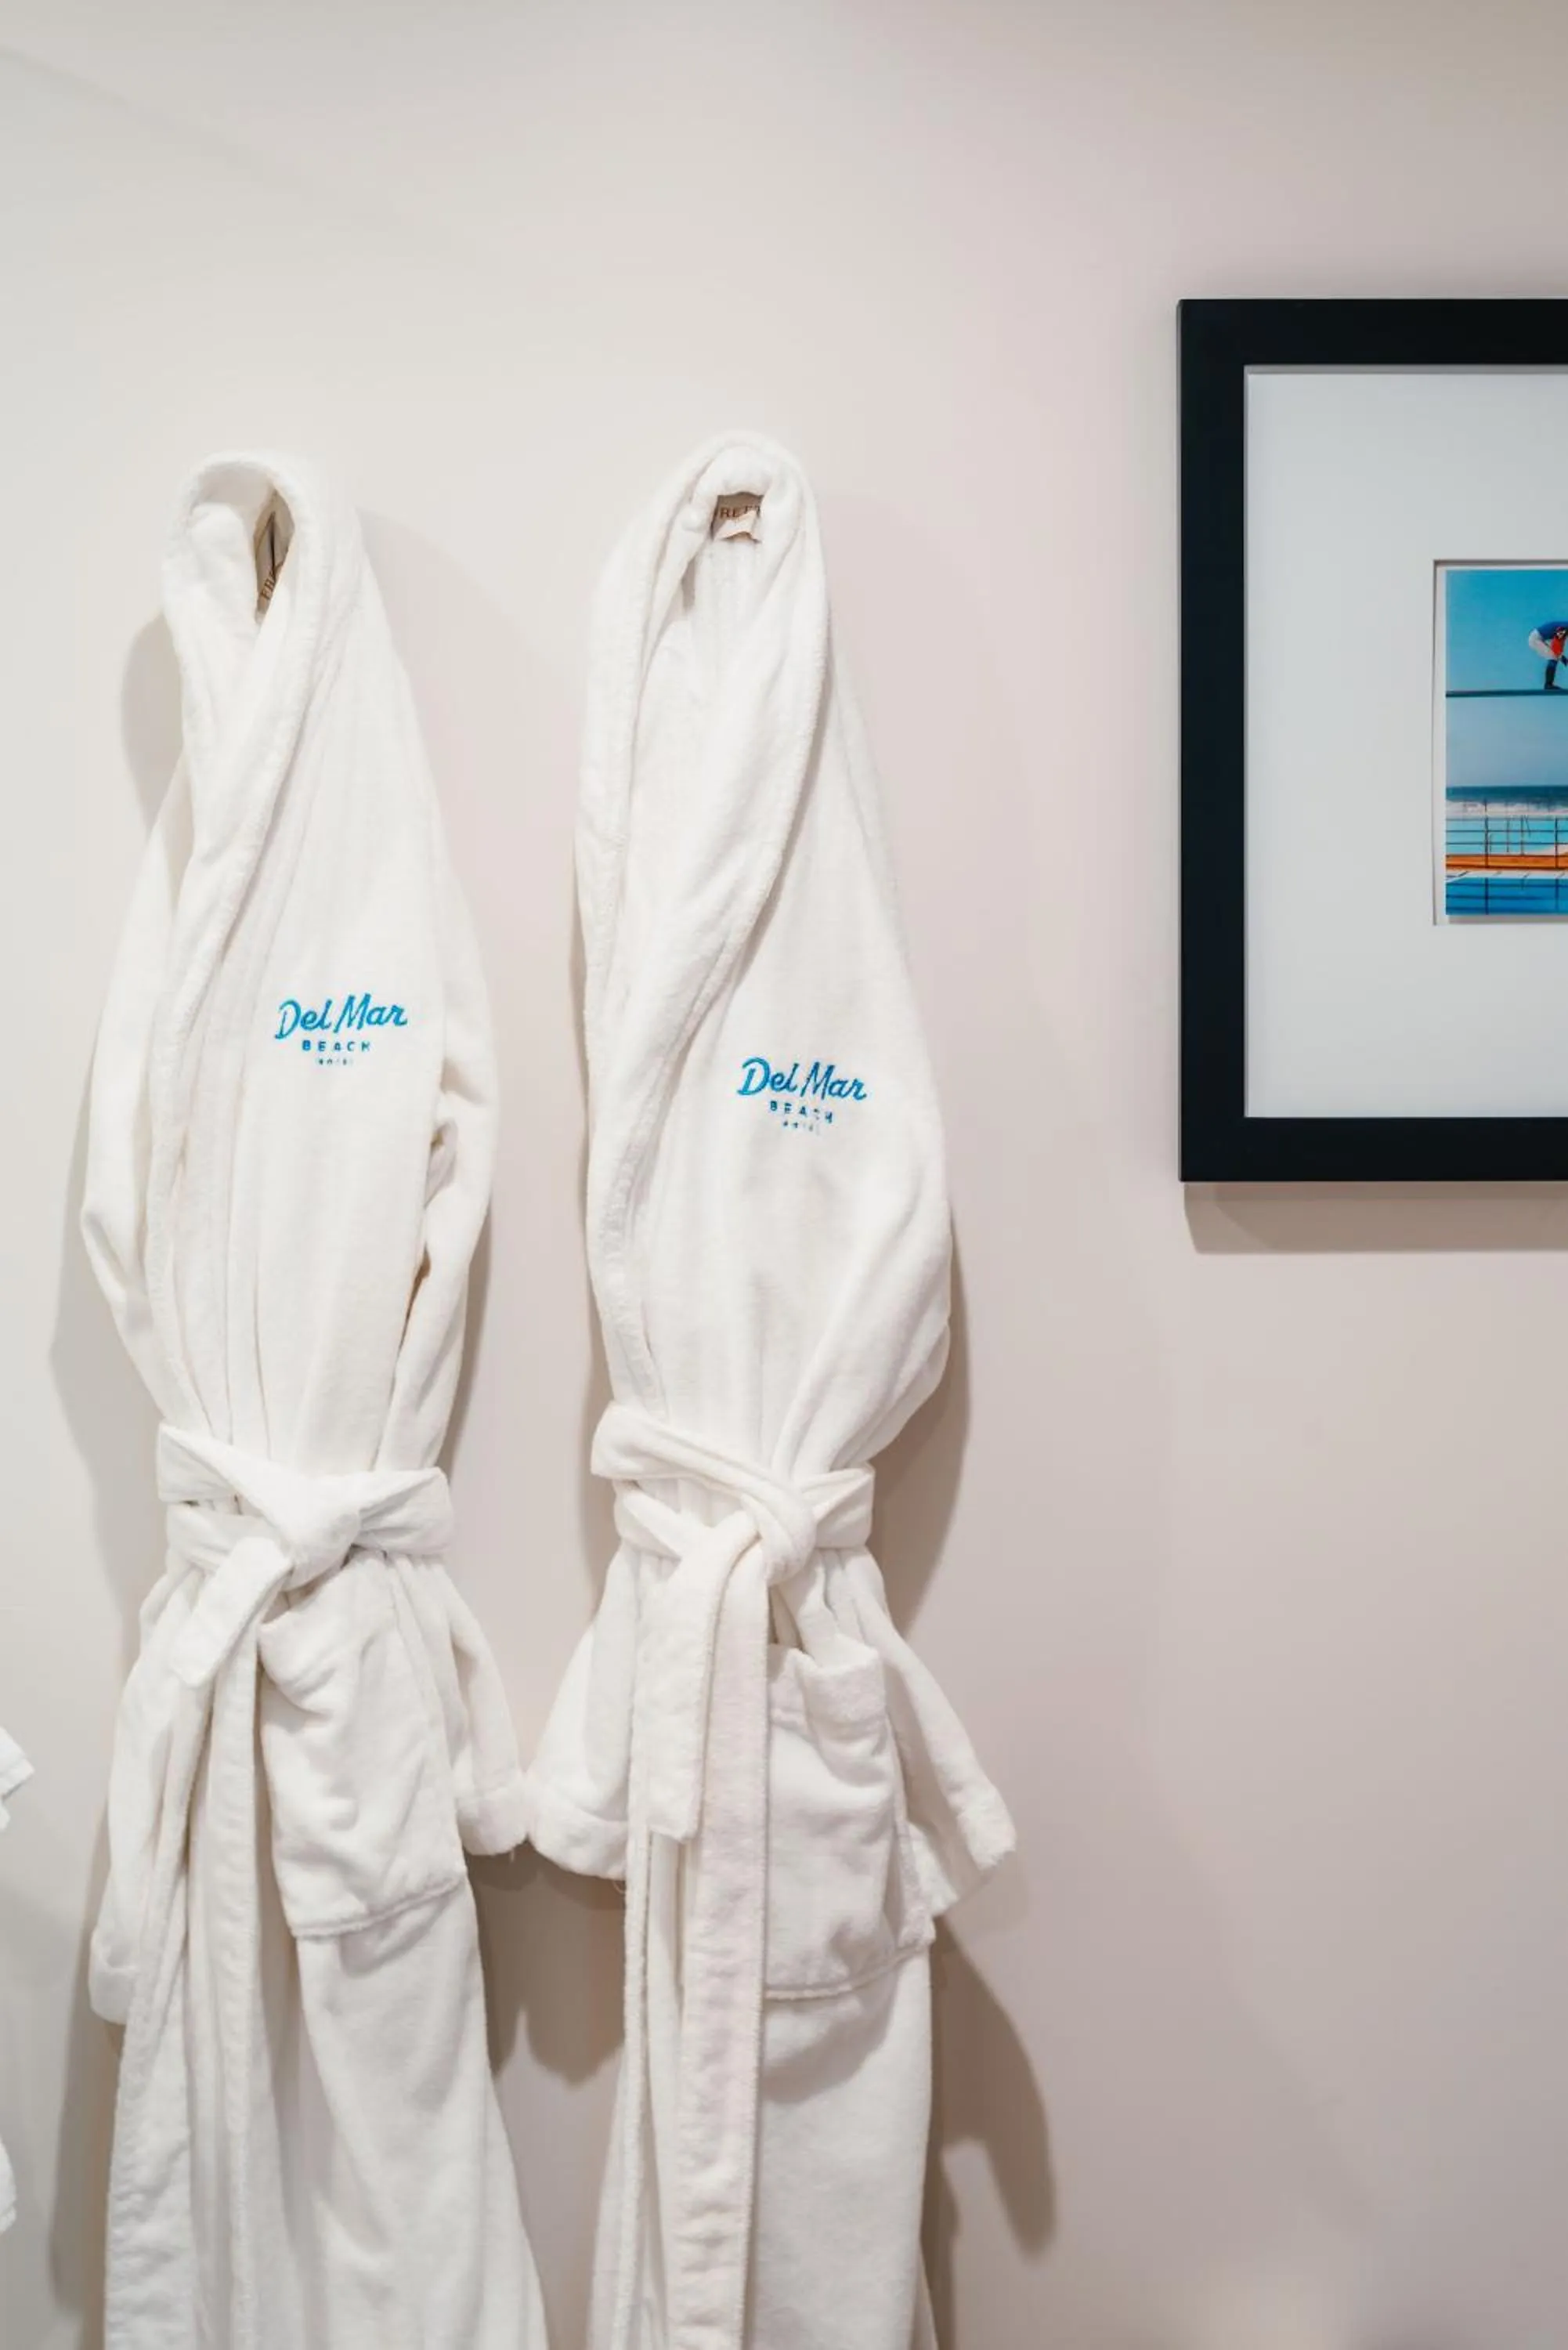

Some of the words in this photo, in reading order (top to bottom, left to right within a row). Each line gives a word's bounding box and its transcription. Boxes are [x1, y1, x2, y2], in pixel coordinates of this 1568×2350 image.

[275, 999, 333, 1039] Del
[333, 992, 408, 1034] Mar
[302, 1039, 370, 1052] BEACH
[737, 1057, 799, 1096] Del
[799, 1061, 867, 1101] Mar
